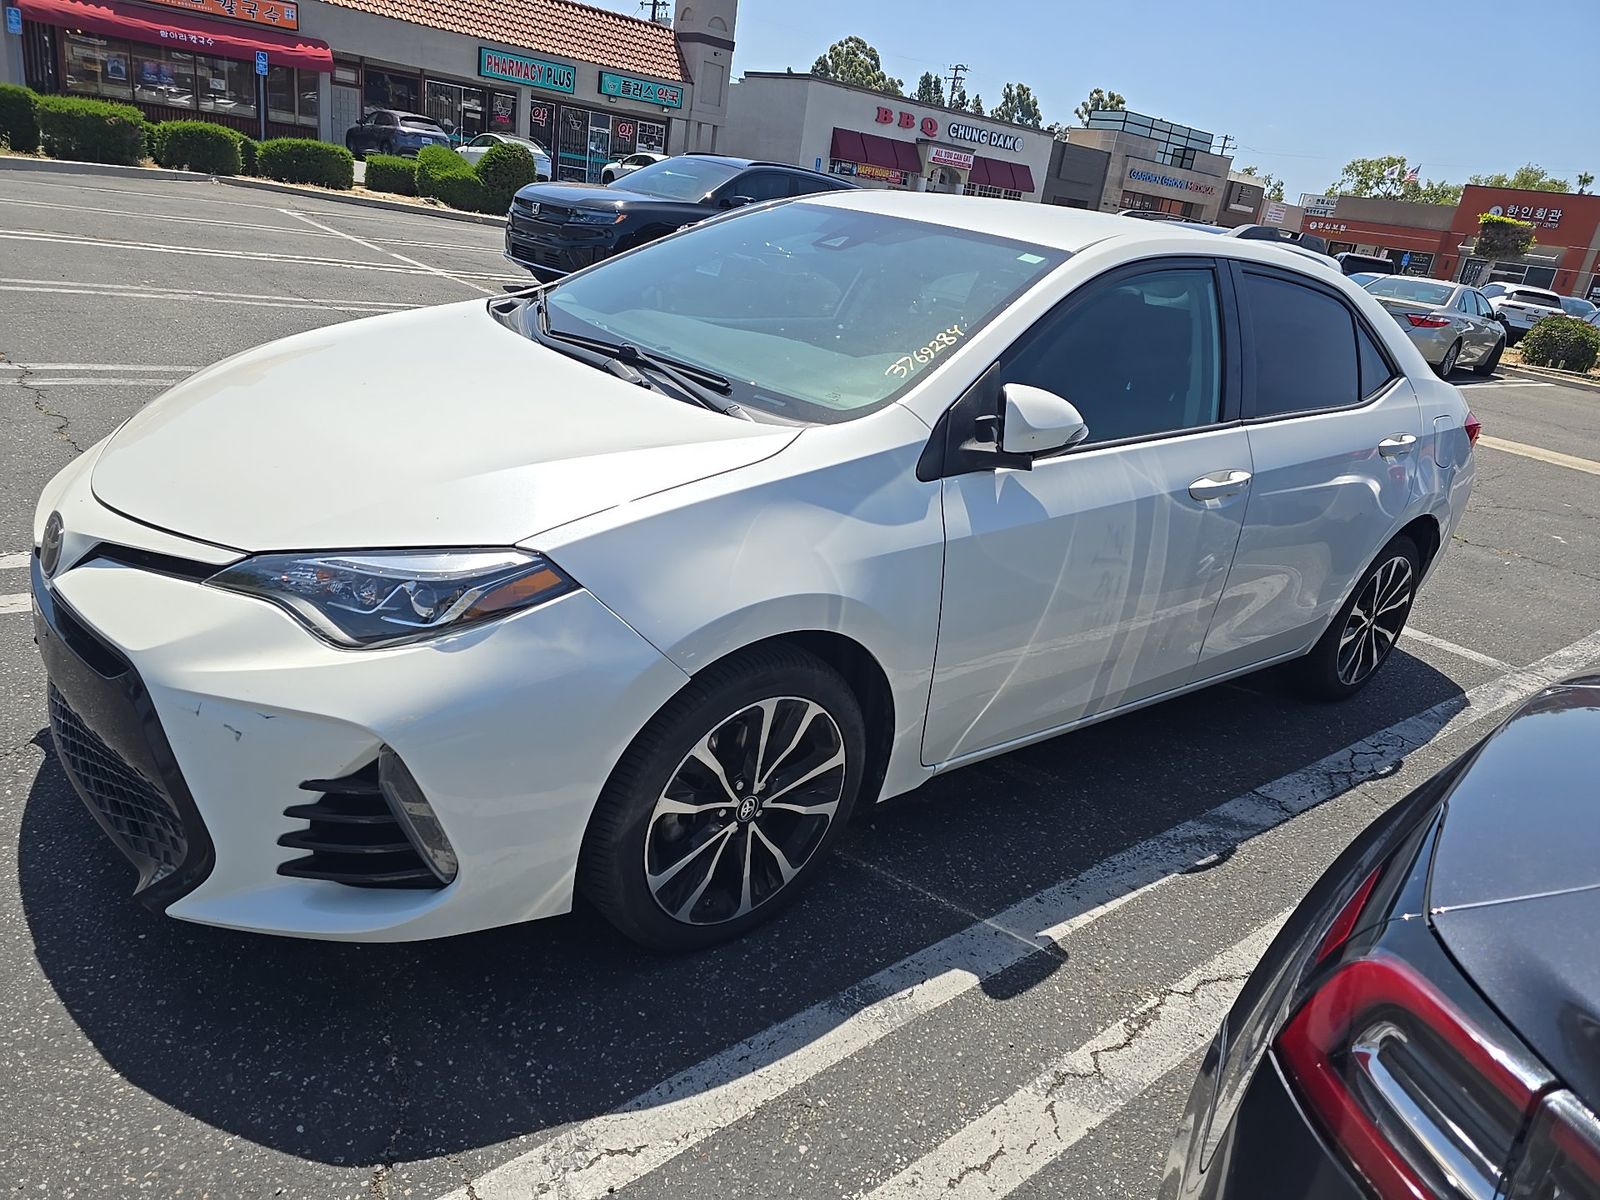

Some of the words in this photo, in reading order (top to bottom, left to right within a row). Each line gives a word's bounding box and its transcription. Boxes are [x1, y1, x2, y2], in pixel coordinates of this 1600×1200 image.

[486, 54, 544, 82] PHARMACY
[546, 67, 573, 89] PLUS
[620, 79, 655, 99] 플러스
[656, 87, 679, 105] 약국
[531, 105, 548, 127] 약
[617, 122, 634, 142] 약
[948, 122, 988, 144] CHUNG
[944, 151, 953, 160] YOU
[857, 164, 875, 175] HAPPY
[1129, 168, 1161, 184] GARDEN
[1161, 175, 1186, 190] GROVE
[1506, 204, 1562, 222] 한인회관
[884, 324, 964, 378] 3769284
